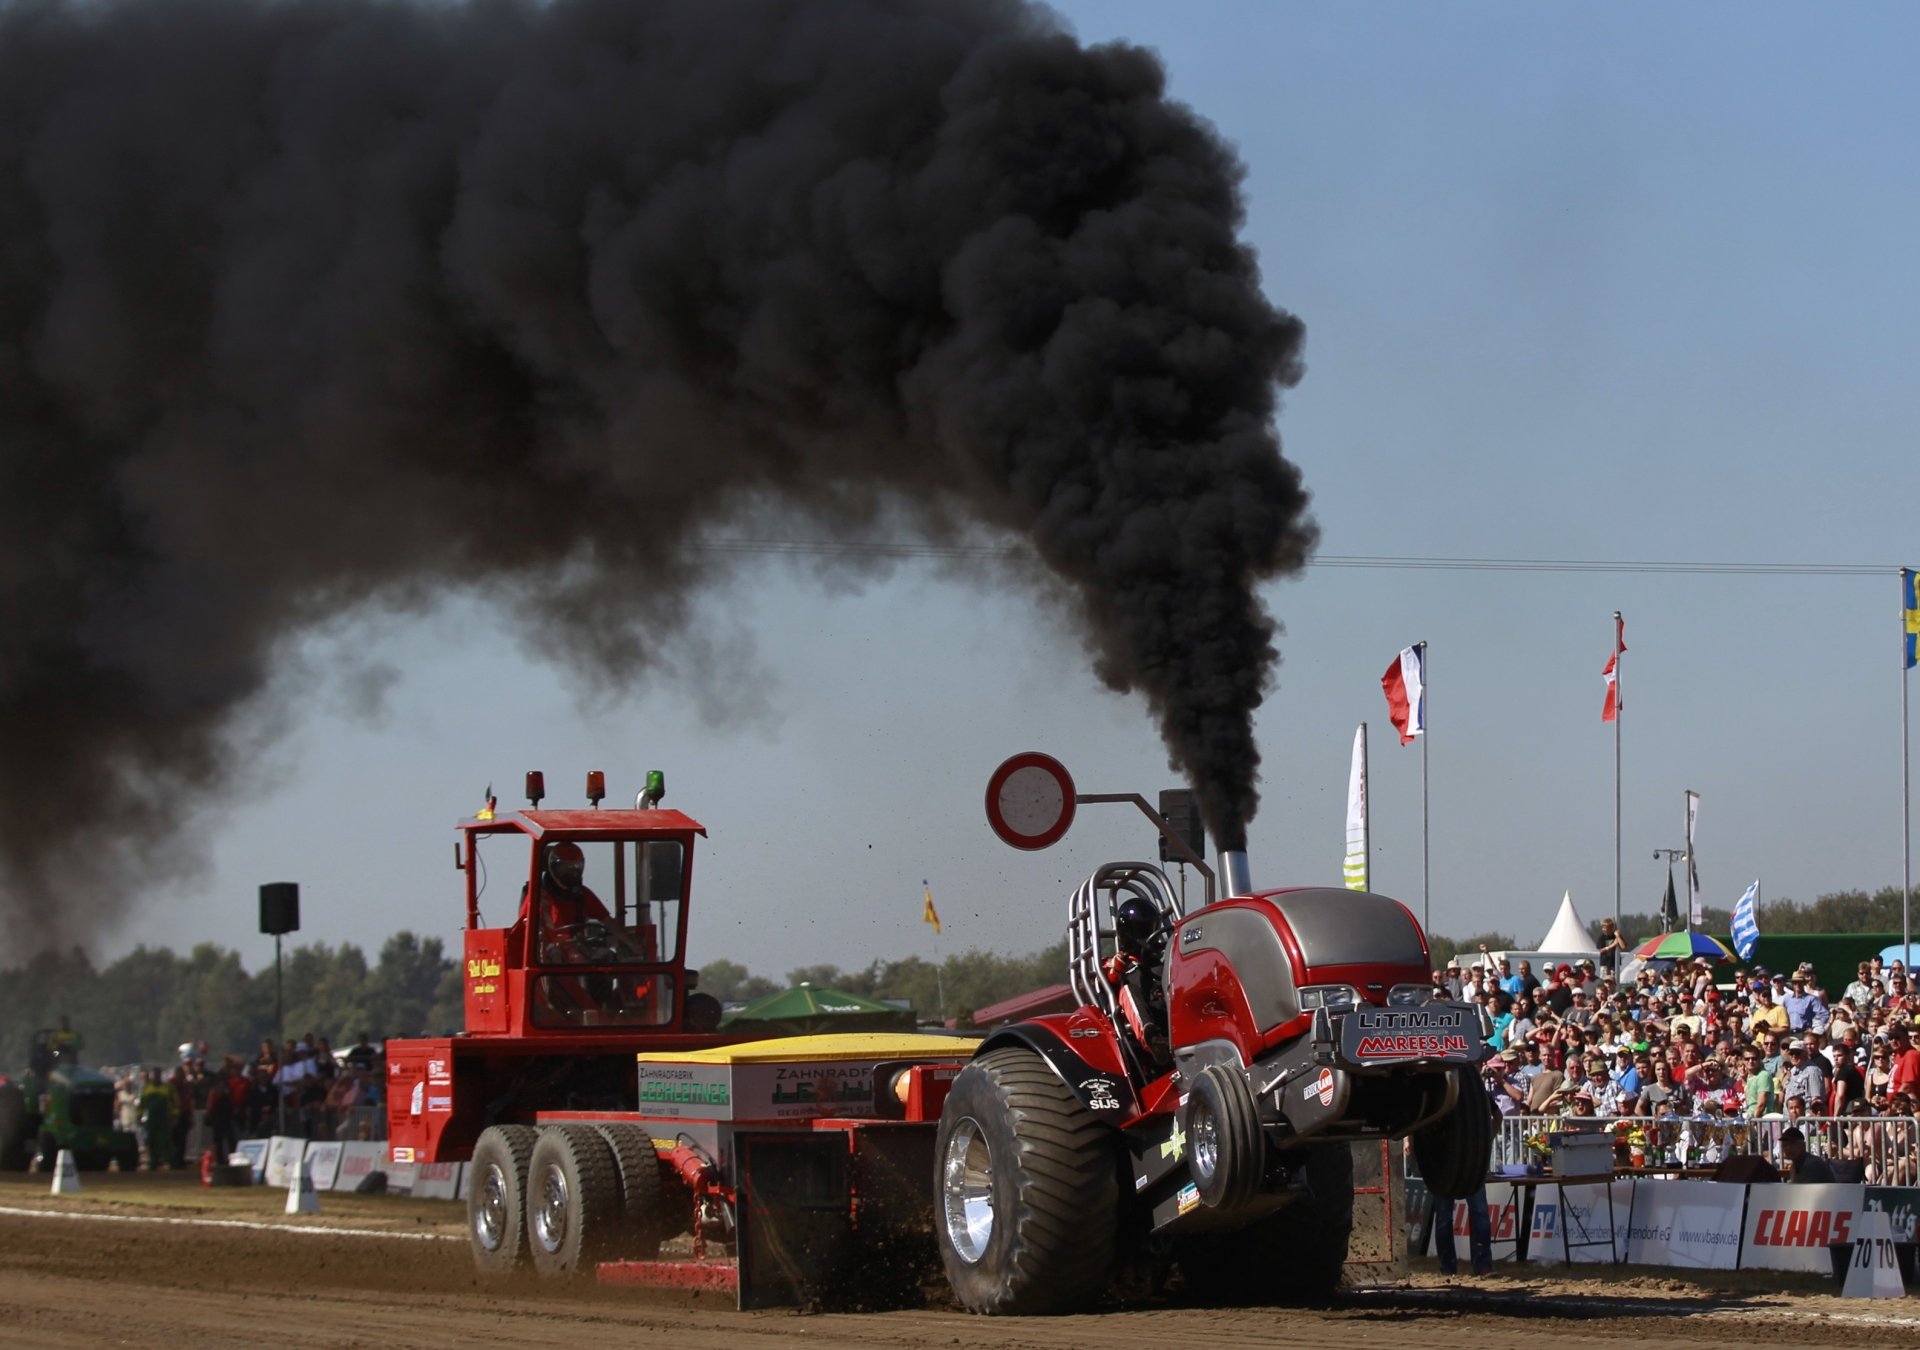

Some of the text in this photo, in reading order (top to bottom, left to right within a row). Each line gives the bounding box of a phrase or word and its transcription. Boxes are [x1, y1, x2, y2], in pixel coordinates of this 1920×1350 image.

[1359, 1011, 1462, 1029] LiTiM.nl
[1357, 1036, 1469, 1052] MAREES.NL
[640, 1067, 694, 1079] ZAHNRADFABRIK
[1089, 1098, 1120, 1110] SIJS
[1678, 1227, 1738, 1245] www.vbasw.de
[1753, 1210, 1853, 1247] CLAAS
[1854, 1237, 1872, 1269] 70
[1876, 1238, 1895, 1269] 70
